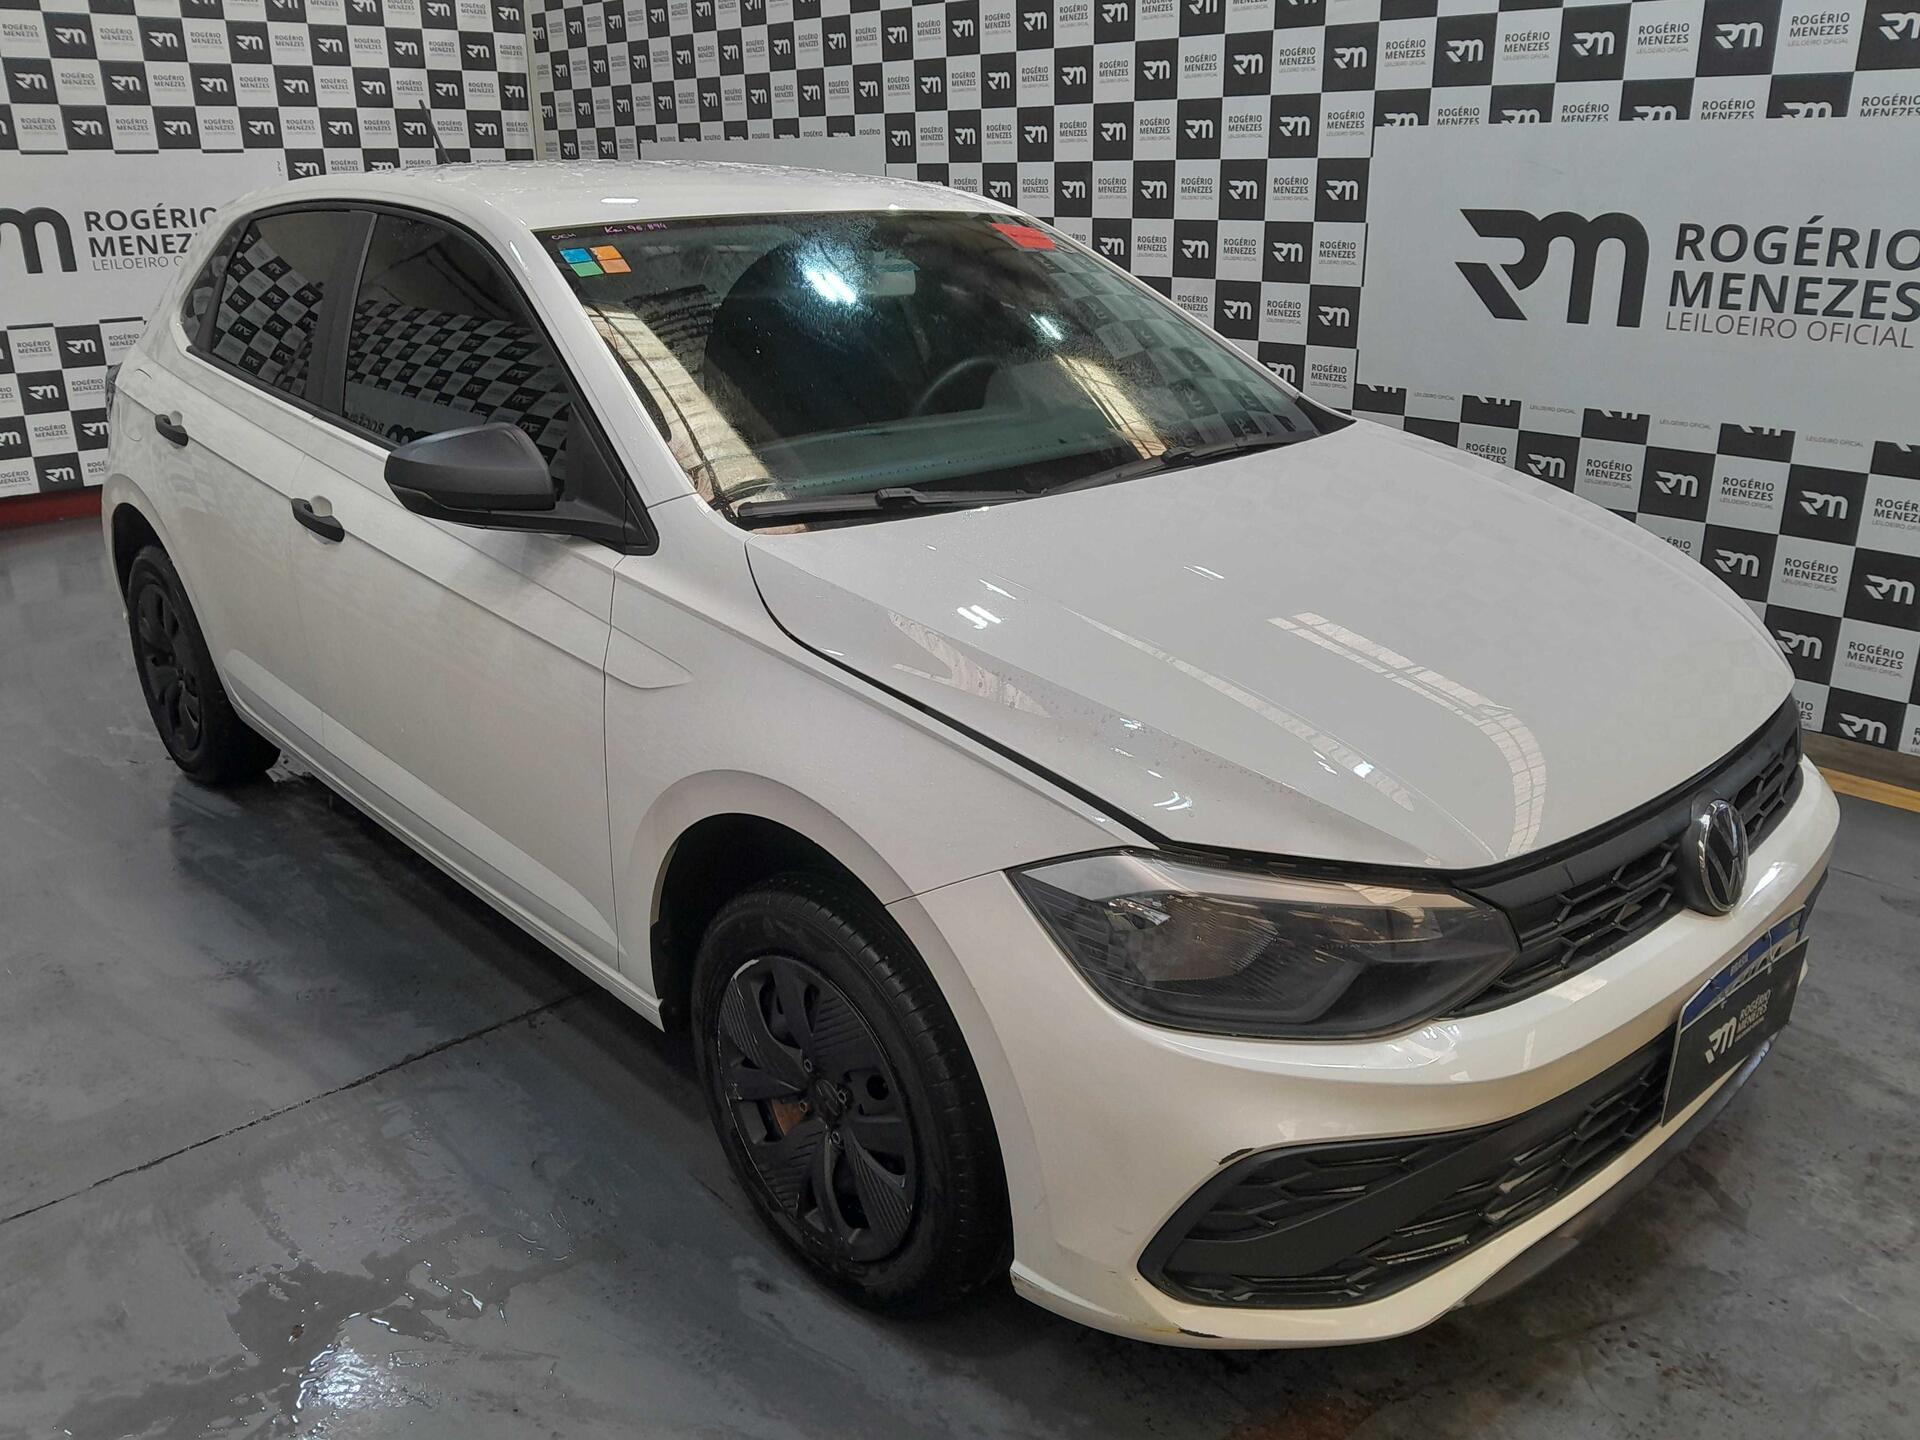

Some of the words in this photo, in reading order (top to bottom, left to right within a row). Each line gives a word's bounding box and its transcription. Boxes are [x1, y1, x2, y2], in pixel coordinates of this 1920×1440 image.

[1060, 4, 1088, 13] ROGÉRIO
[1060, 12, 1088, 21] MENEZES
[1791, 11, 1850, 25] ROGÉRIO
[1639, 22, 1689, 35] ROGÉRIO
[1790, 24, 1848, 37] MENEZES
[1505, 31, 1550, 42] ROGÉRIO
[1638, 34, 1688, 45] MENEZES
[1386, 39, 1426, 50] ROGÉRIO
[1504, 42, 1549, 52] MENEZES
[1280, 47, 1316, 57] ROGÉRIO
[1385, 49, 1425, 59] MENEZES
[1185, 54, 1217, 63] ROGÉRIO
[1279, 56, 1315, 65] MENEZES
[1099, 60, 1128, 69] ROGÉRIO
[1185, 63, 1217, 71] MENEZES
[1022, 66, 1048, 74] ROGÉRIO
[1099, 68, 1128, 77] MENEZES
[1022, 74, 1048, 82] MENEZES
[1562, 102, 1609, 114] ROGÉRIO
[1702, 97, 1755, 111] ROGÉRIO
[1328, 110, 1365, 120] ROGÉRIO
[1438, 105, 1480, 117] ROGÉRIO
[1140, 118, 1170, 126] ROGÉRIO
[1229, 114, 1262, 123] ROGÉRIO
[1060, 120, 1087, 129] ROGÉRIO
[1228, 123, 1262, 132] MENEZES
[1327, 120, 1364, 129] MENEZES
[1060, 129, 1087, 137] MENEZES
[1140, 126, 1170, 134] MENEZES
[1098, 177, 1126, 185] ROGÉRIO
[1181, 176, 1213, 185] ROGÉRIO
[1274, 176, 1308, 185] ROGÉRIO
[1273, 186, 1308, 194] MENEZES
[1137, 235, 1167, 244] ROGÉRIO
[1224, 237, 1256, 246] ROGÉRIO
[1675, 215, 1920, 271] ROGÉRIO
[88, 233, 192, 258] MENEZ
[1137, 244, 1167, 252] MENEZES
[1320, 240, 1356, 250] ROGÉRIO
[1223, 247, 1256, 255] MENEZES
[1319, 250, 1356, 259] MENEZES
[92, 256, 169, 271] LEILOEIRO
[1177, 295, 1208, 303] ROGÉRIO
[1668, 271, 1920, 322] MENEZES
[1177, 303, 1208, 311] MENEZES
[1267, 300, 1301, 309] ROGÉRIO
[1267, 309, 1301, 318] MENEZES
[1665, 312, 1798, 339] LEILOEIRO
[1806, 320, 1915, 348] OFICIAL
[1312, 364, 1347, 374] ROGÉRIO
[1311, 372, 1347, 382] MENEZES
[1466, 442, 1507, 456] ROGÉRIO
[1587, 459, 1632, 472] ROGÉRIO
[1586, 468, 1632, 483] MENEZES
[1723, 477, 1774, 491] ROGÉRIO
[1721, 487, 1773, 503] MENEZES
[1875, 497, 1920, 512] ROGÉR
[1785, 558, 1838, 574] ROGÉRIO
[1783, 567, 1837, 584] MENEZES
[1849, 641, 1904, 659] ROGÉRIO
[1847, 651, 1903, 670] MENEZES
